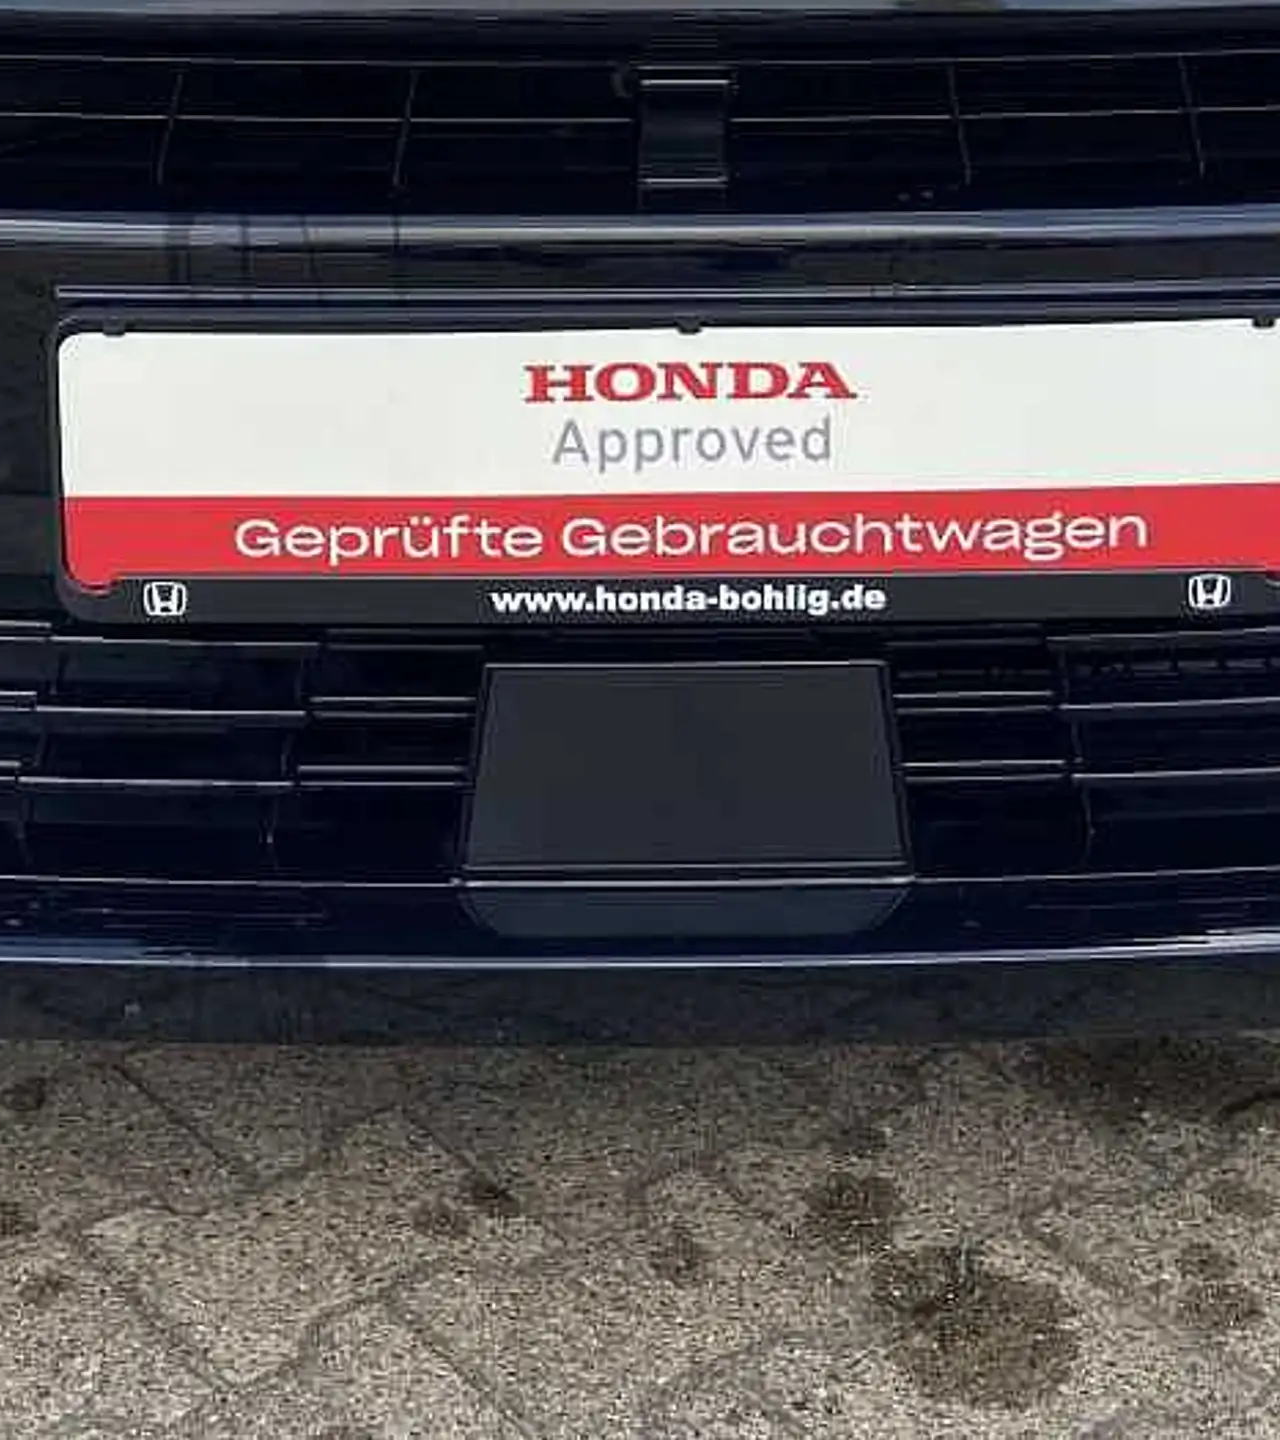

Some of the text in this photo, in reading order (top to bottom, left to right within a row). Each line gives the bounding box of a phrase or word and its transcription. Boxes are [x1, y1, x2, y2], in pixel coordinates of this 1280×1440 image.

[524, 362, 858, 403] HONDA
[552, 416, 832, 473] Approved
[234, 510, 1148, 567] Geprüfte Gebrauchtwagen
[490, 583, 887, 615] www.honda-bohlig.de
